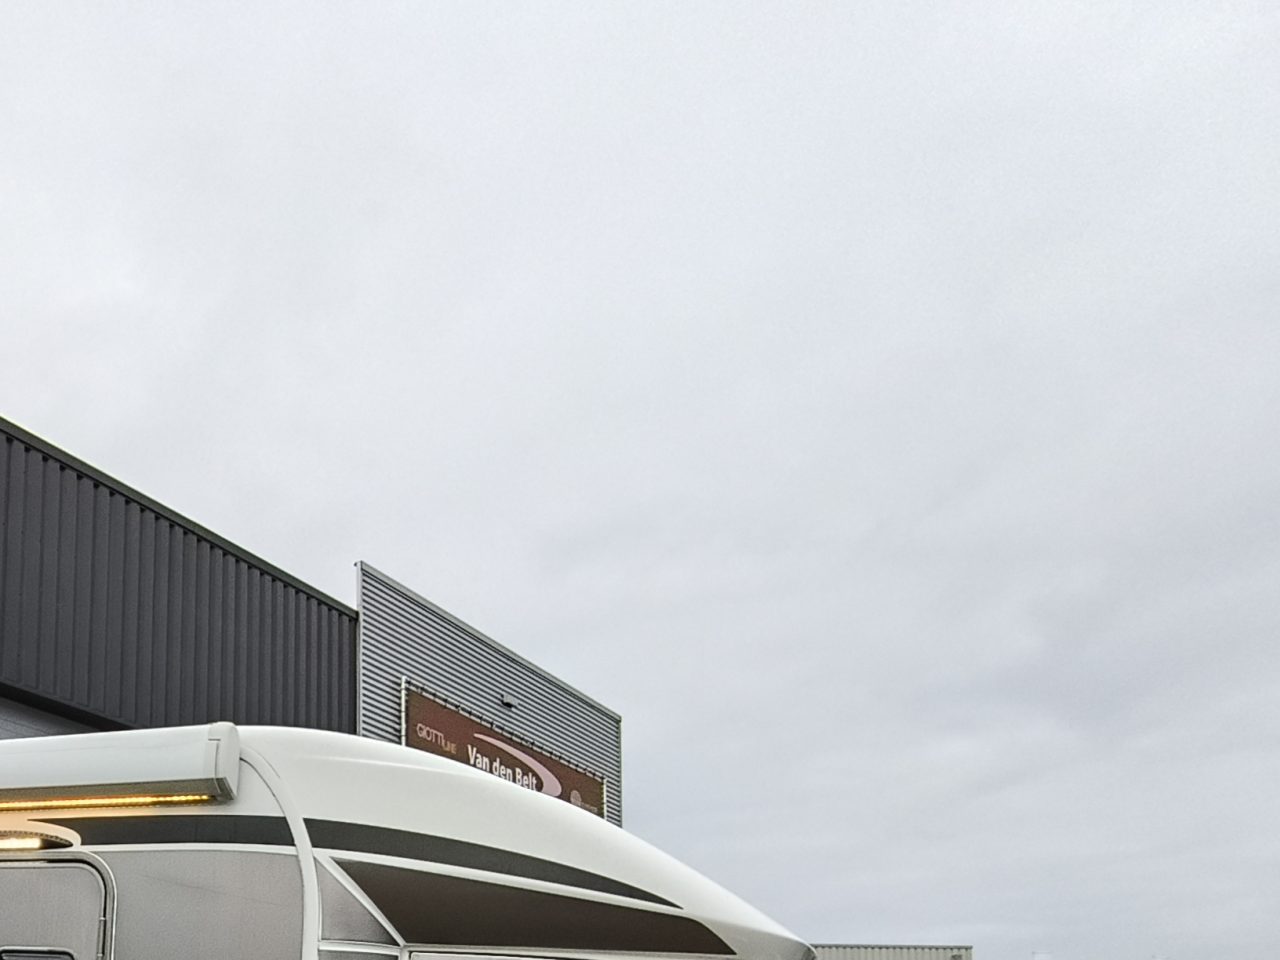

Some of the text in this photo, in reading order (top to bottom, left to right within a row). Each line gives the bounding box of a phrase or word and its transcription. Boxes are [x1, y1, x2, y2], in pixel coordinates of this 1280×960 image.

[467, 744, 537, 791] Van den Belt
